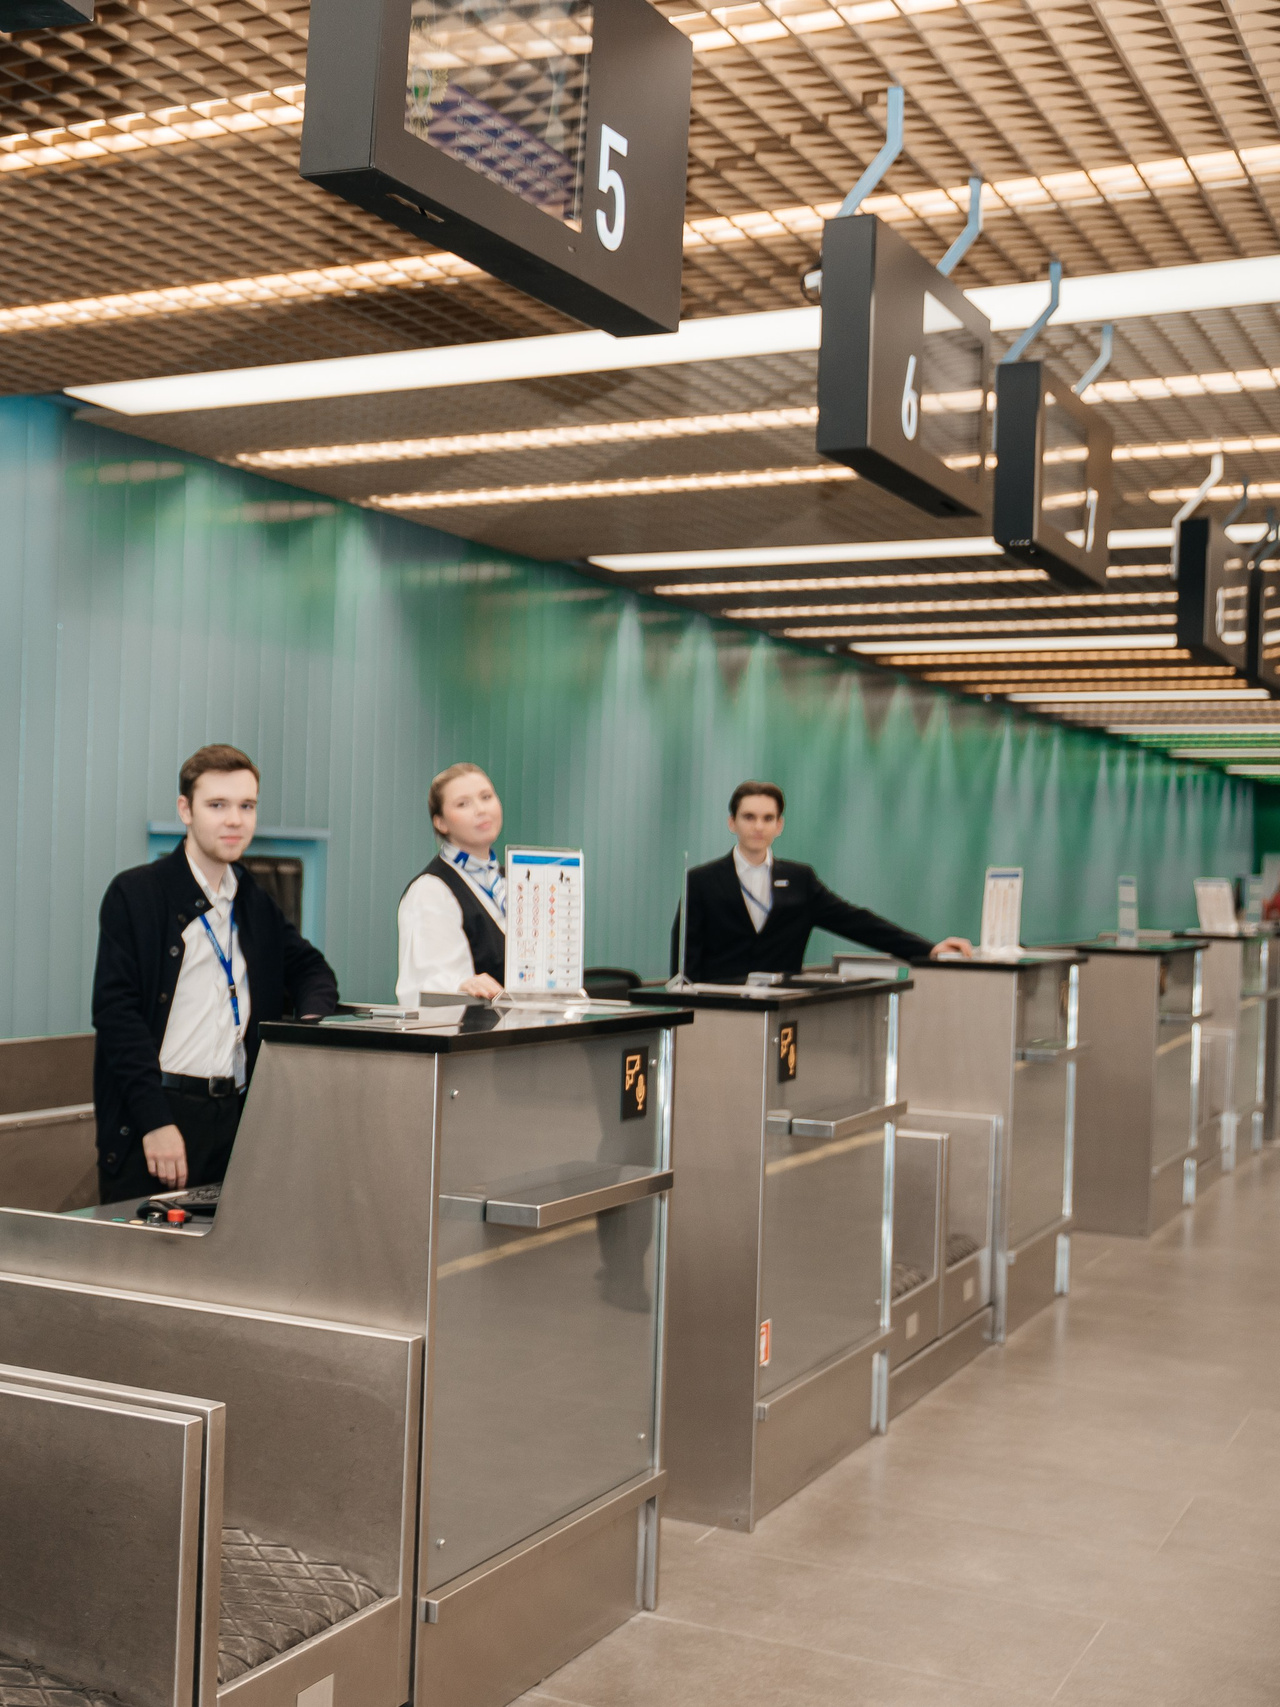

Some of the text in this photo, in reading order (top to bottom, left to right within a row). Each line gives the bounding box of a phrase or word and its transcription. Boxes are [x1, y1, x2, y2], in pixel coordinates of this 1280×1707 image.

[596, 123, 629, 252] 5
[901, 354, 919, 441] 6
[1086, 487, 1099, 553] 7
